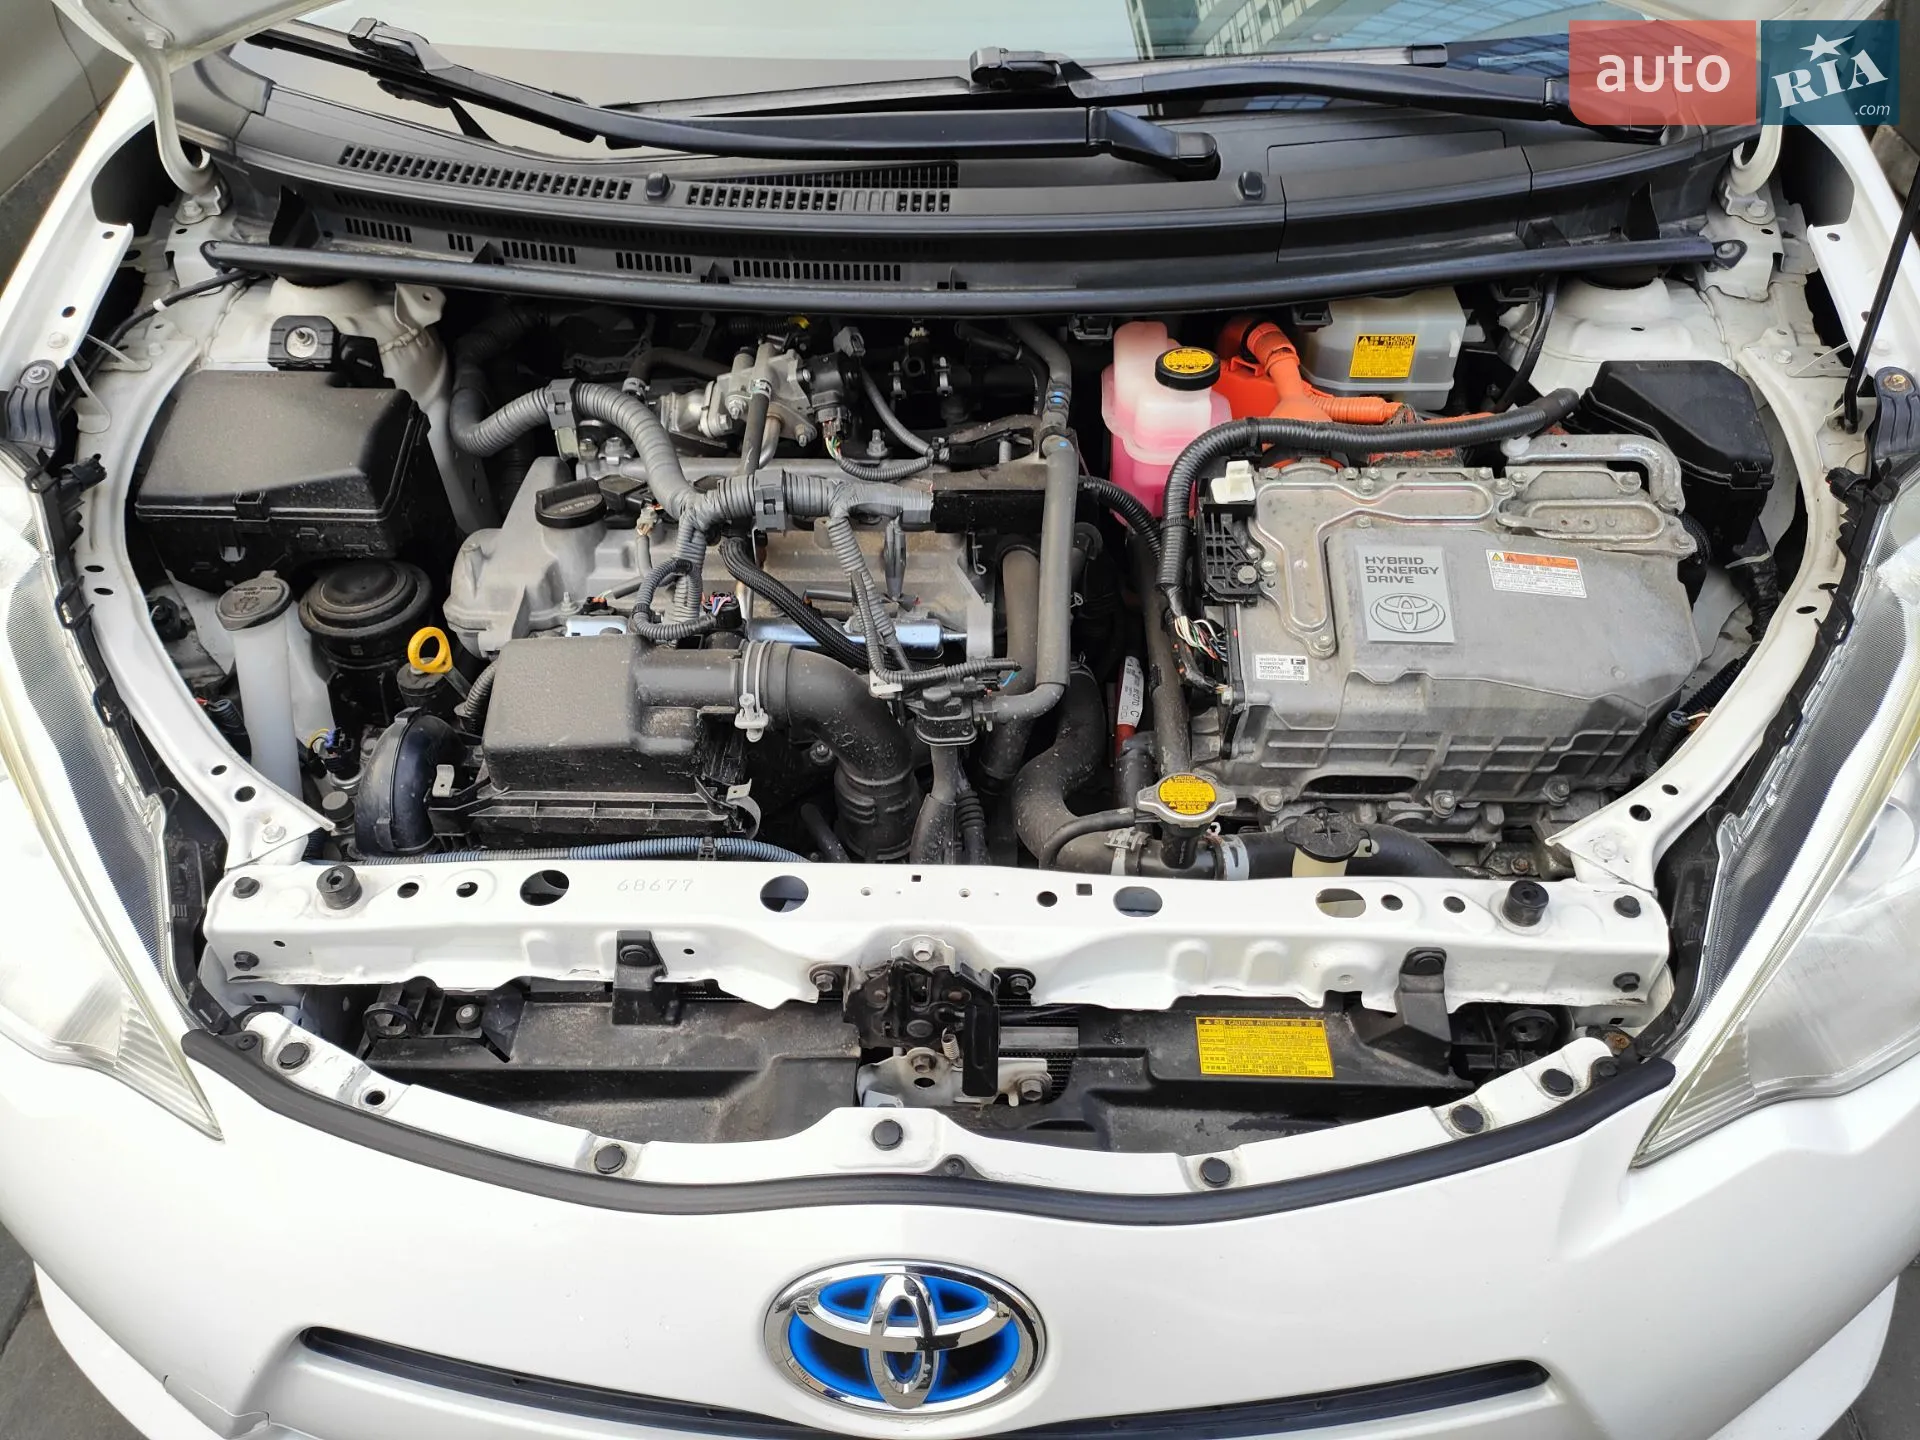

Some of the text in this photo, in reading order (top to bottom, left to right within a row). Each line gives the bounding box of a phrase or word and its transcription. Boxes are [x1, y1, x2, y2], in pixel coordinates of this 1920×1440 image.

[1364, 556, 1424, 565] HYBRID
[1366, 566, 1439, 575] SYNERGY
[1367, 575, 1415, 584] DRIVE
[617, 879, 694, 892] 68677
